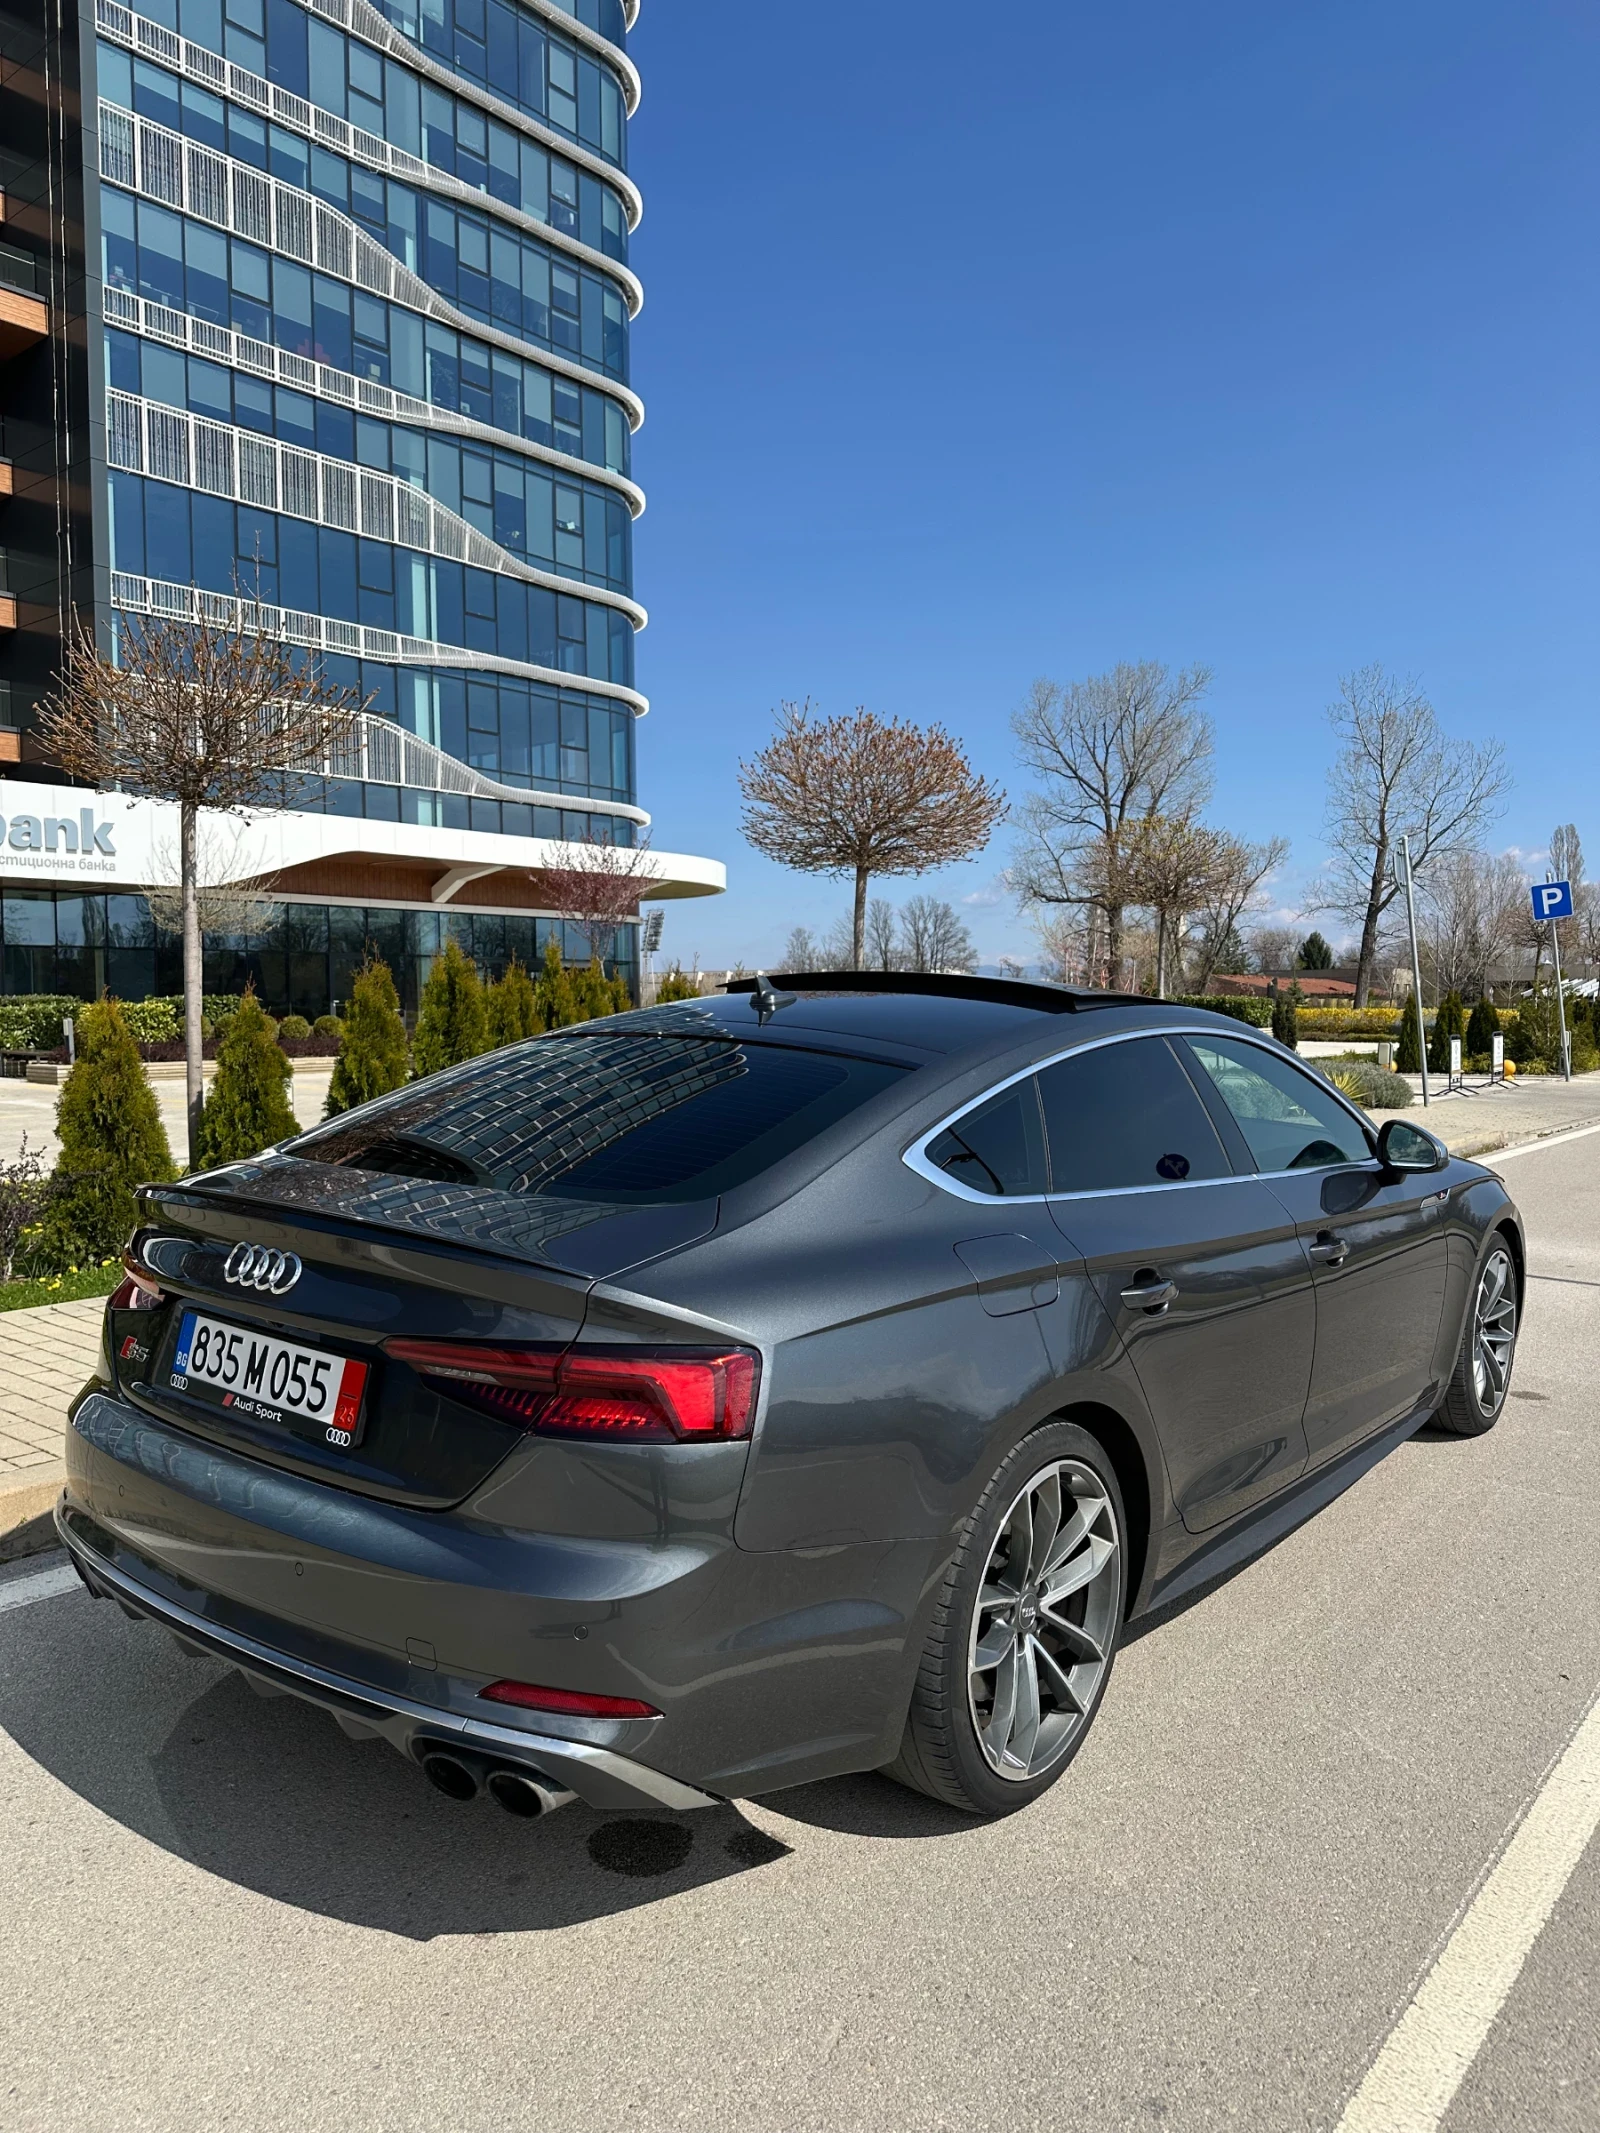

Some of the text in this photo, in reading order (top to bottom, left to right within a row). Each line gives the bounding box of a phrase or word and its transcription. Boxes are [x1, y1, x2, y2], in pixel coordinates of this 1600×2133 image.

[0, 808, 117, 856] ank
[79, 858, 116, 872] банка
[1541, 887, 1563, 915] P
[176, 1351, 188, 1367] BG
[233, 1396, 283, 1423] Audi Sport
